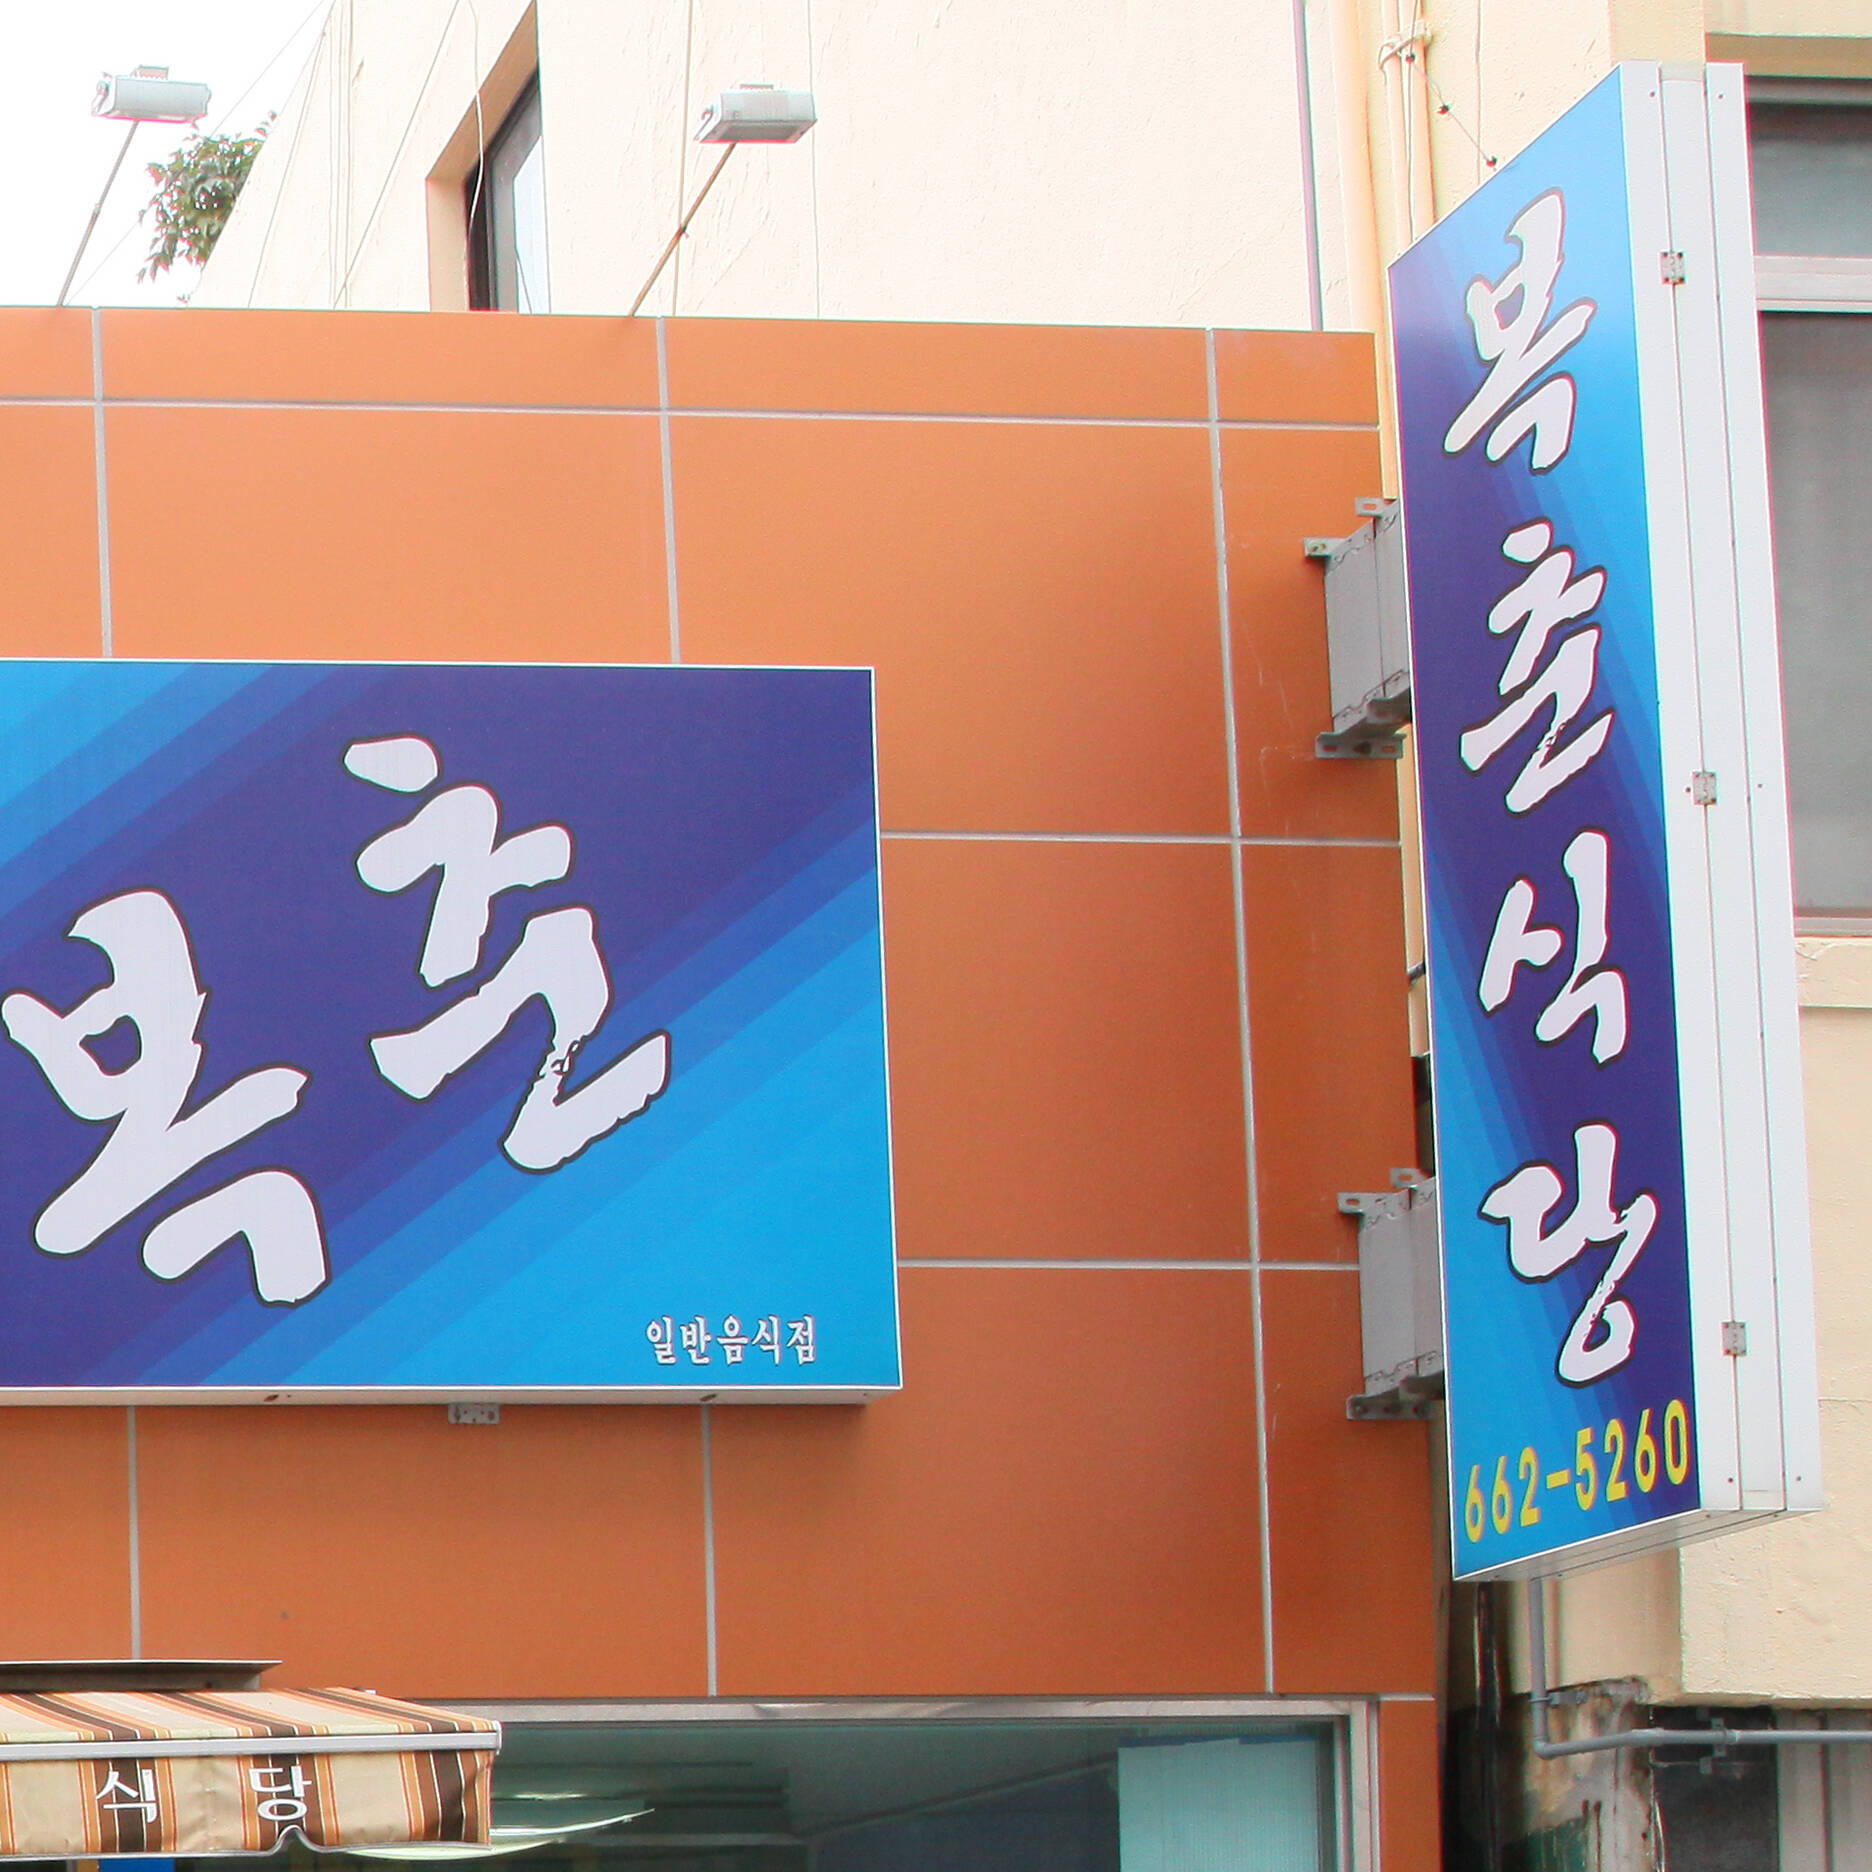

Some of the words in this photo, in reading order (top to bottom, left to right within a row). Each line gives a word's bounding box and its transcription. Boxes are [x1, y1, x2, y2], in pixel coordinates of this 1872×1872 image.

[1444, 188, 1656, 1385] 복춘식당
[1, 731, 671, 1305] 복춘
[646, 1314, 816, 1366] 일반음식점
[1464, 1395, 1691, 1546] 662-5260
